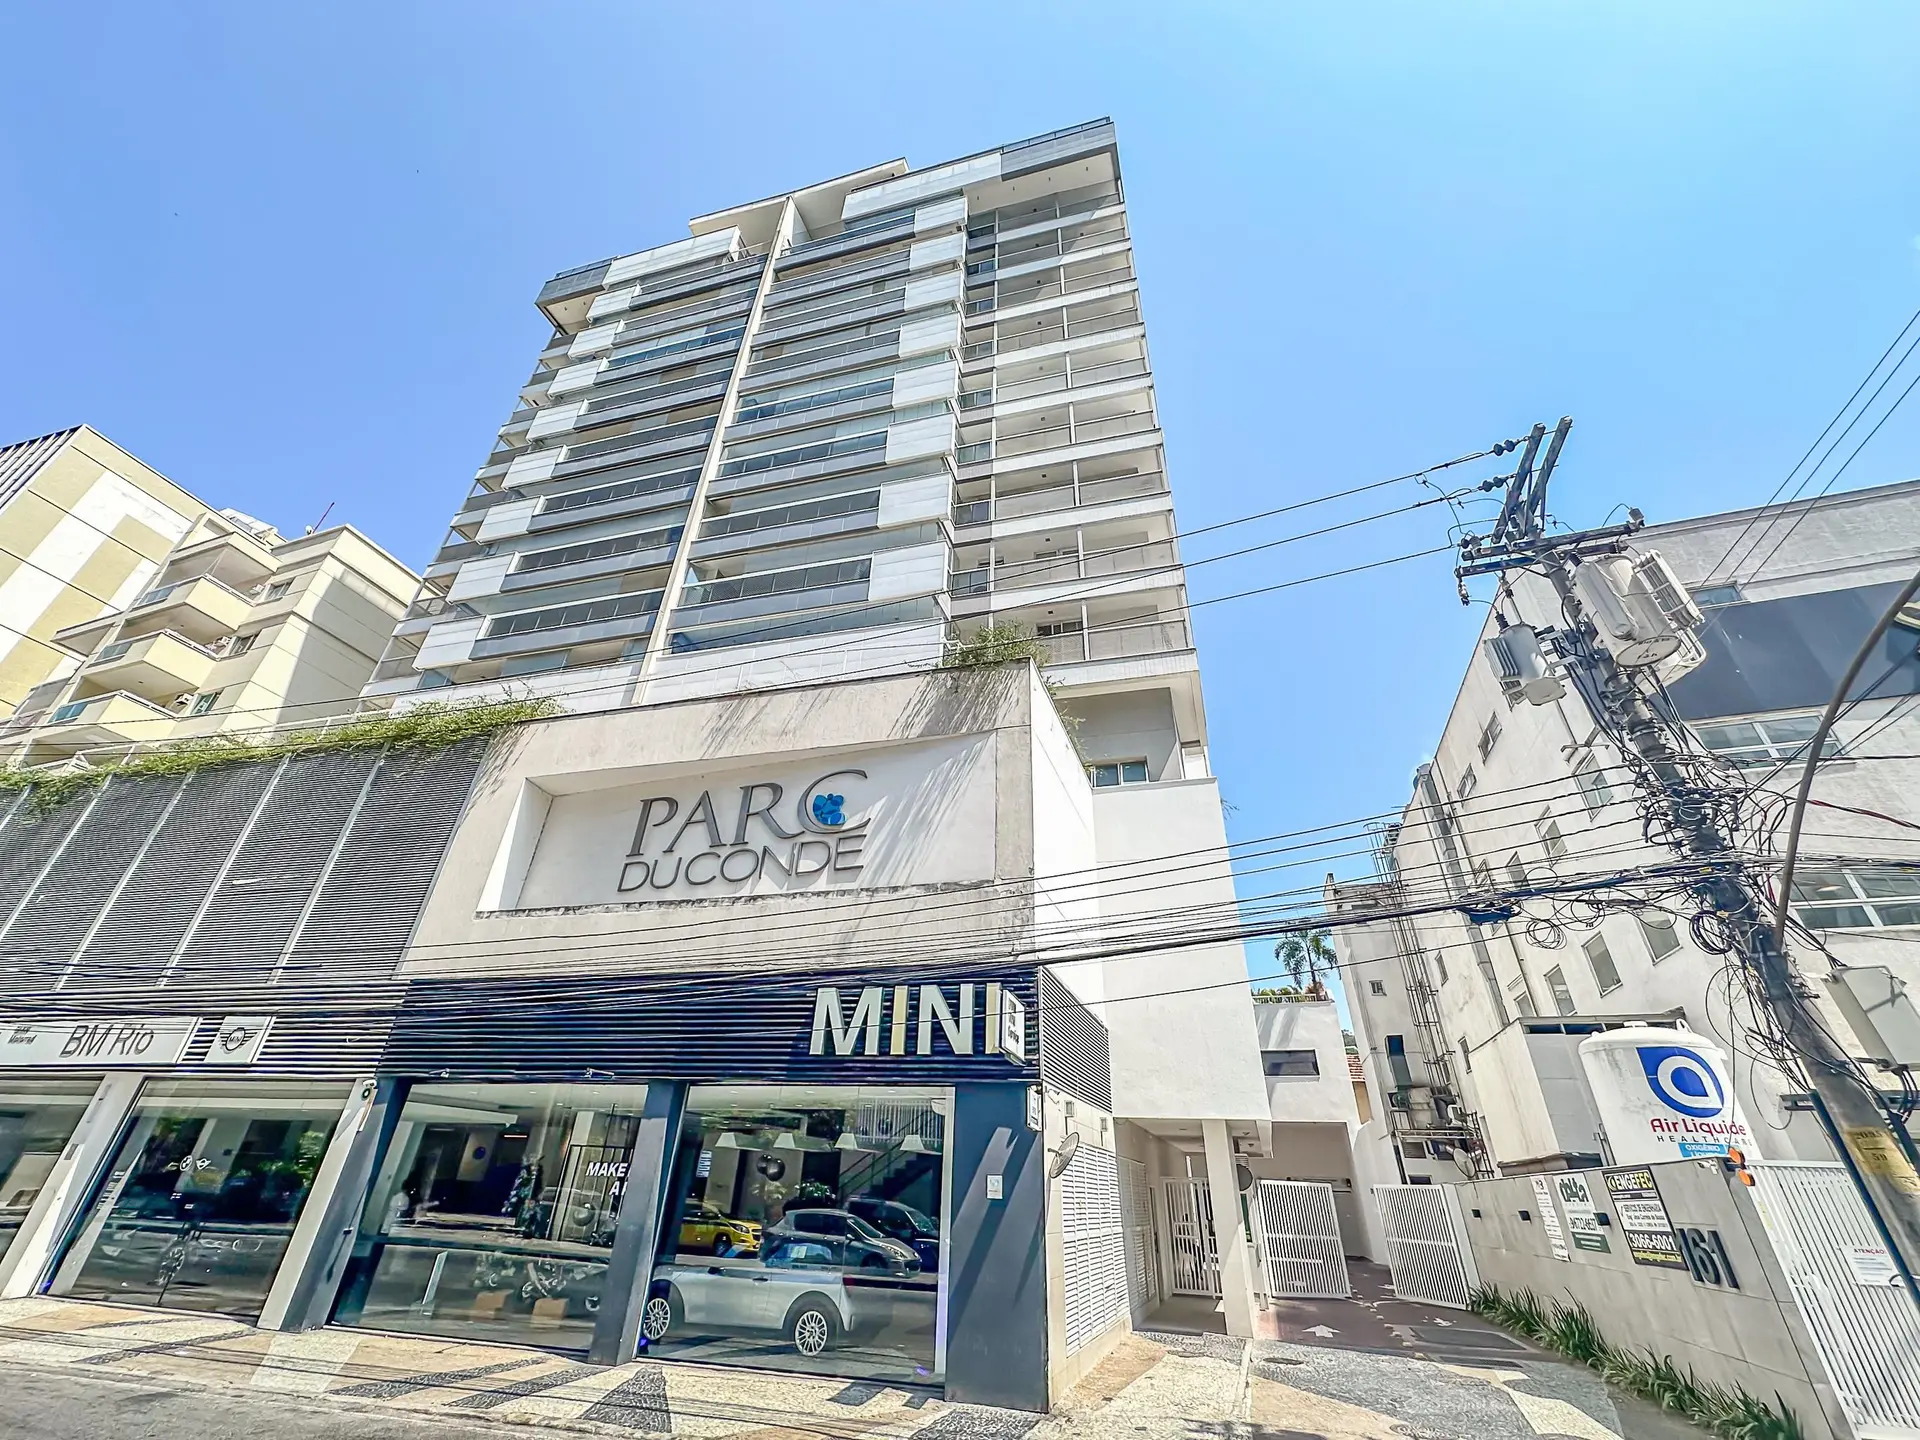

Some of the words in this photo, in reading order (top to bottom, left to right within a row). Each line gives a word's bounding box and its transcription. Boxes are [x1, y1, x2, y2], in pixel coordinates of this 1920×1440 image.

[626, 769, 871, 857] PARC
[809, 983, 1002, 1055] MINI
[59, 1025, 114, 1057] BM
[107, 1023, 154, 1055] Rio
[1650, 1118, 1679, 1133] Air
[1682, 1119, 1746, 1137] Liquide
[586, 1162, 628, 1177] MAKE
[1614, 1171, 1653, 1190] ENGEFEC
[1676, 1228, 1740, 1290] 161
